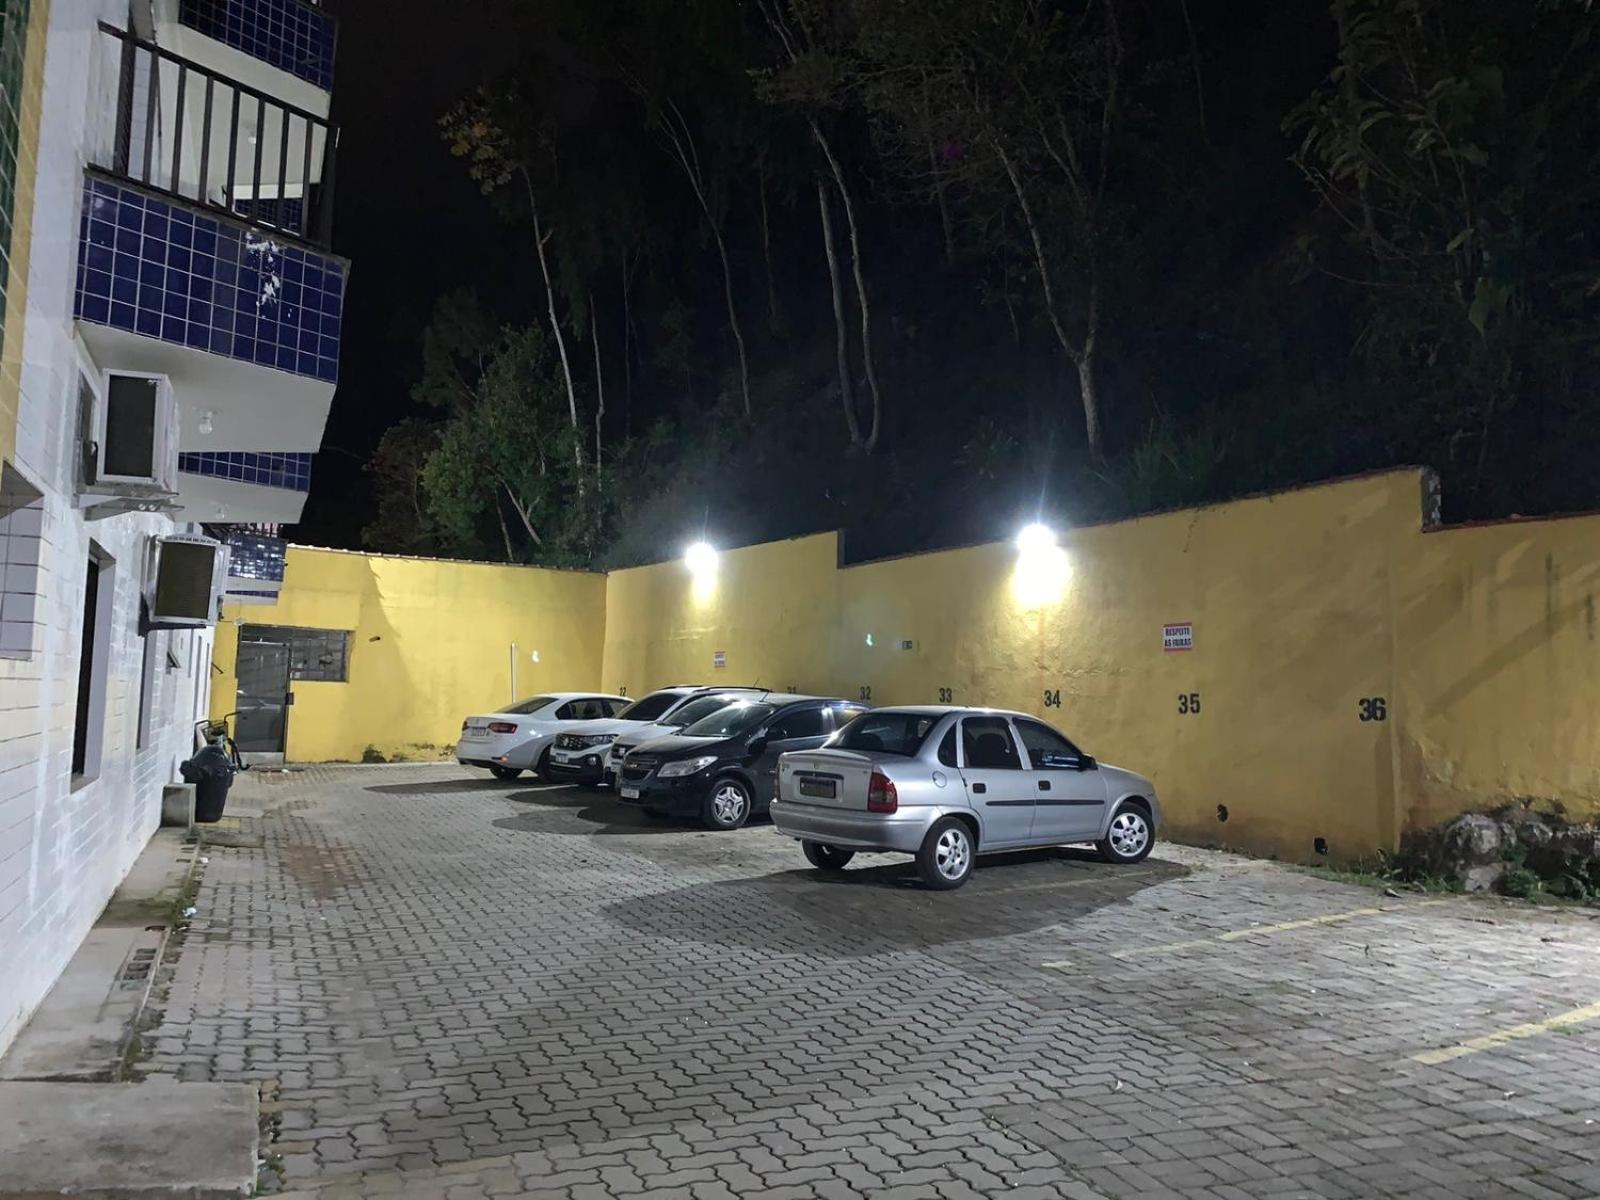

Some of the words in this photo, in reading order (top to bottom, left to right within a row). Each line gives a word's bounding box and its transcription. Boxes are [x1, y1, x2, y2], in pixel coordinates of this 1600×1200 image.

[860, 686, 871, 700] 32
[939, 687, 952, 703] 33
[1044, 689, 1061, 708] 34
[1178, 693, 1201, 714] 35
[1358, 697, 1386, 721] 36
